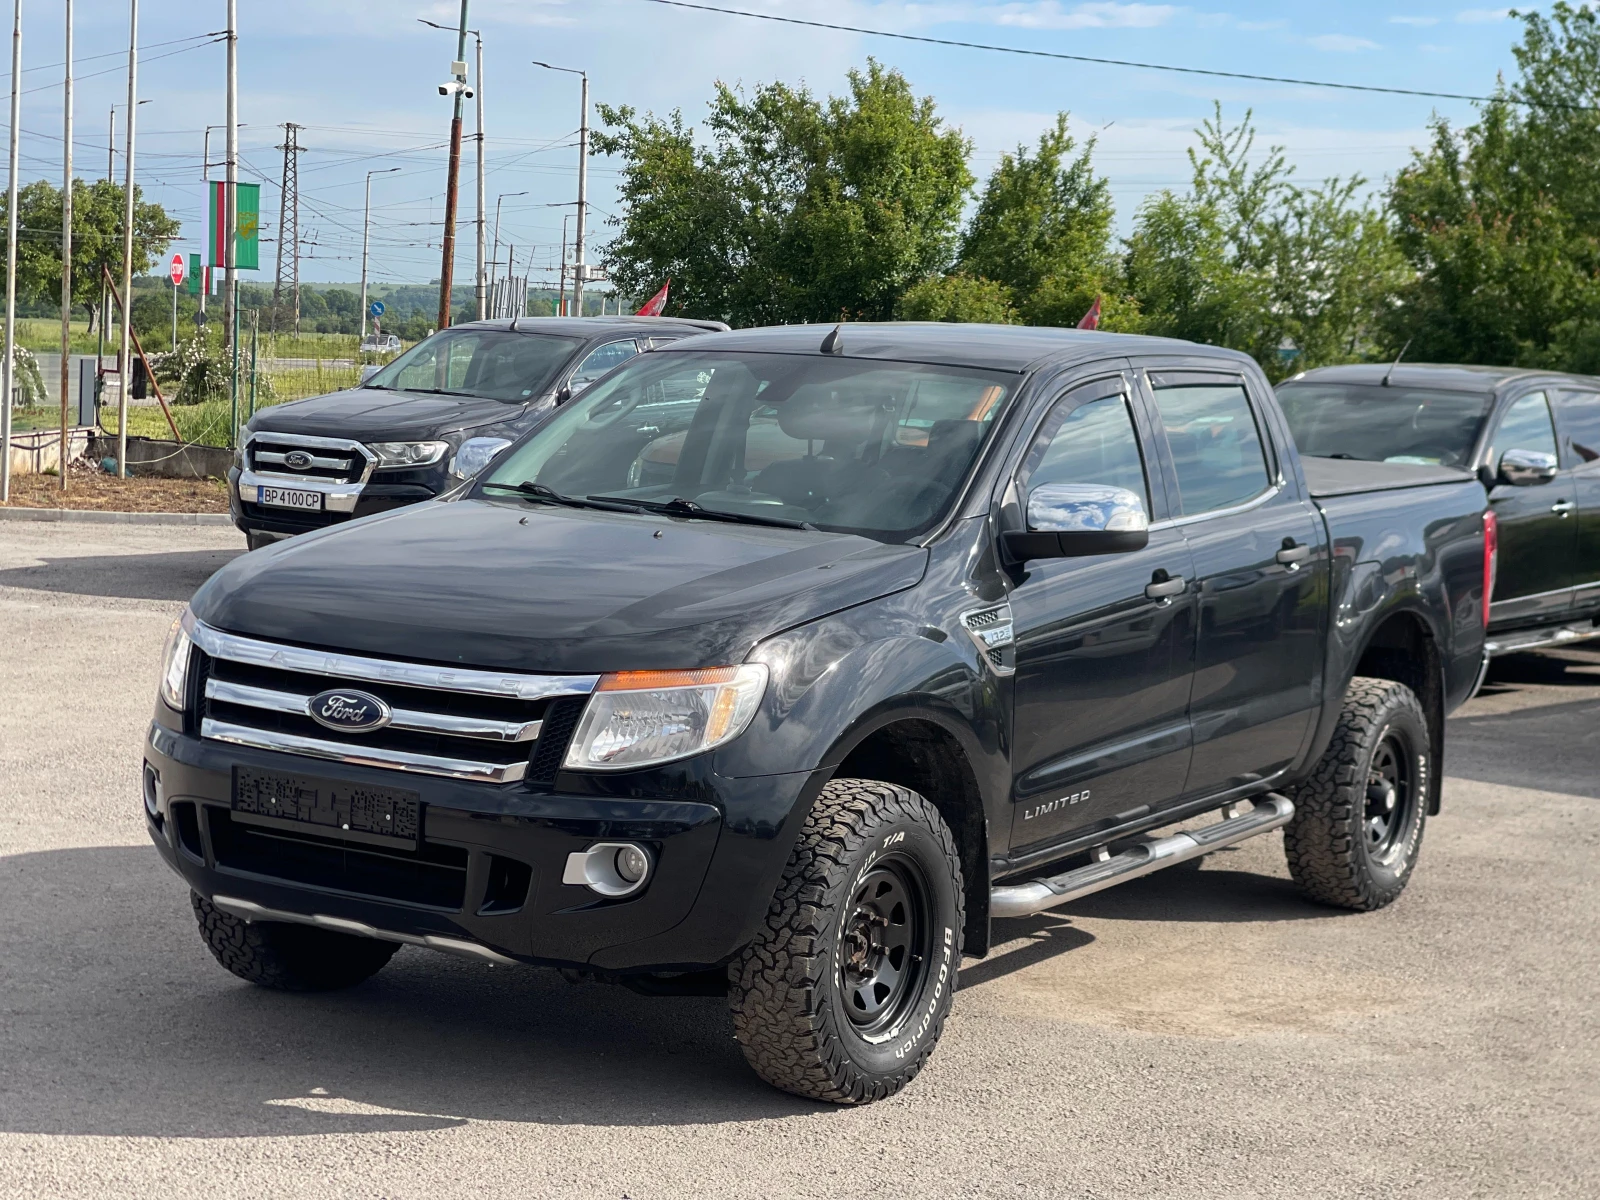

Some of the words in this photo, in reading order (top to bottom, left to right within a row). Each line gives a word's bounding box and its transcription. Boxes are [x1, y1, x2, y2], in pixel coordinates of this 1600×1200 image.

[172, 263, 183, 275] STOP
[288, 454, 305, 465] Ford
[264, 489, 278, 503] BP
[280, 491, 304, 506] 4100
[305, 493, 319, 508] CP
[321, 694, 368, 722] Ford
[1024, 789, 1090, 820] LIMITED
[882, 831, 906, 849] T/A
[895, 926, 953, 1060] BFGoodrich
